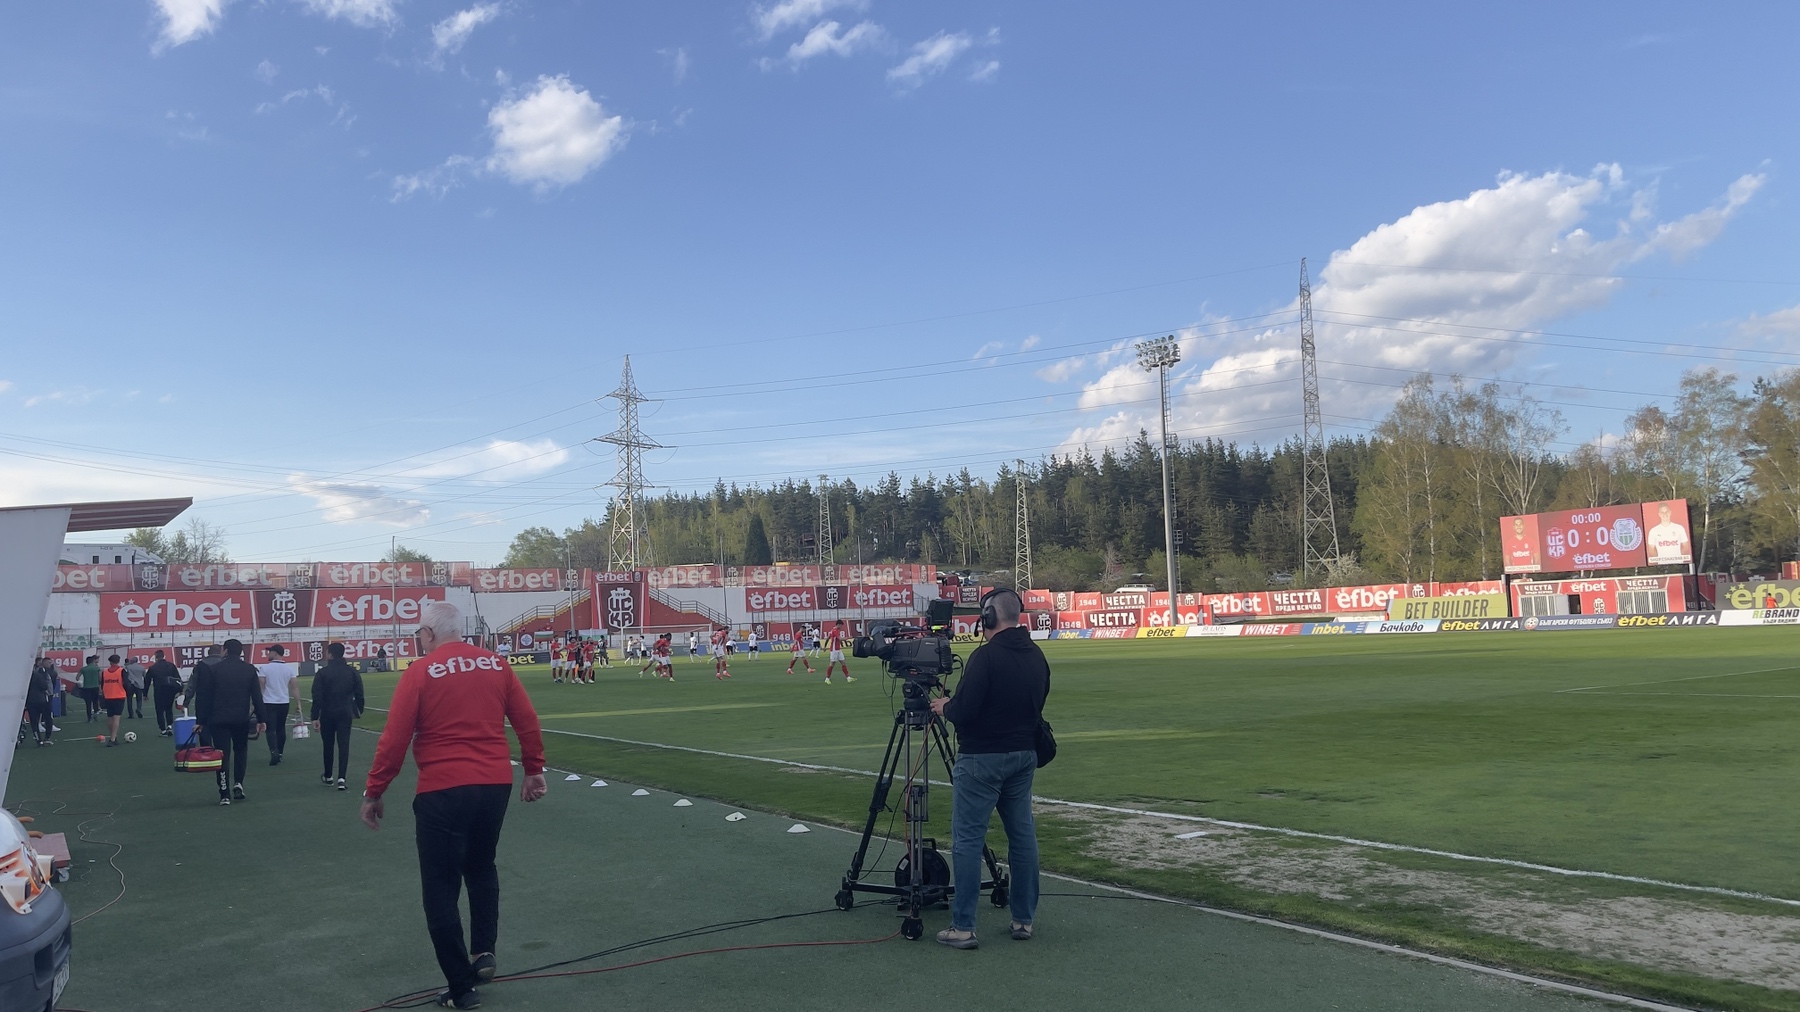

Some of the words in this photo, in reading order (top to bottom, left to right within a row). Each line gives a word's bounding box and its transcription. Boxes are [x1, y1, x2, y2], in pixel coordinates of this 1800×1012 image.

[1572, 513, 1600, 524] 00:00
[1568, 529, 1579, 547] 0
[1596, 527, 1608, 545] 0
[1574, 552, 1610, 564] efbet
[52, 566, 104, 588] bet
[180, 565, 272, 586] efbet
[330, 564, 412, 584] efbet
[480, 570, 553, 589] efbet
[596, 572, 629, 581] efbet
[648, 567, 711, 585] efbet
[753, 566, 811, 583] efbet
[850, 566, 903, 581] efbet
[1571, 582, 1606, 592] efbet
[750, 591, 811, 609] efbet
[856, 588, 910, 605] efbet
[1106, 595, 1145, 606] ЧЕСТТА
[1274, 592, 1321, 604] ЧЕСТТА
[1337, 587, 1398, 608] efbet
[1731, 584, 1800, 609] efb
[330, 594, 435, 621] efbet
[1213, 595, 1262, 613] efbet
[1405, 602, 1428, 619] BET
[1432, 599, 1489, 618] BUILDER
[118, 598, 240, 627] efbet
[1090, 612, 1136, 626] ЧЕСТТА
[1753, 609, 1799, 618] REBRAND
[1380, 622, 1424, 632] Бачково
[1442, 621, 1480, 630] efbet
[1480, 620, 1519, 629] ЛИГА
[1619, 615, 1667, 626] efbet
[1668, 615, 1717, 625] ЛИГА
[1095, 629, 1126, 638] WINBET
[1147, 628, 1175, 637] efbet
[1245, 625, 1288, 635] WINBET
[1312, 624, 1345, 634] inbet
[955, 633, 973, 641] bet
[342, 640, 408, 658] efbet
[54, 658, 77, 667] 948
[507, 654, 535, 664] bet
[428, 655, 503, 678] efbet
